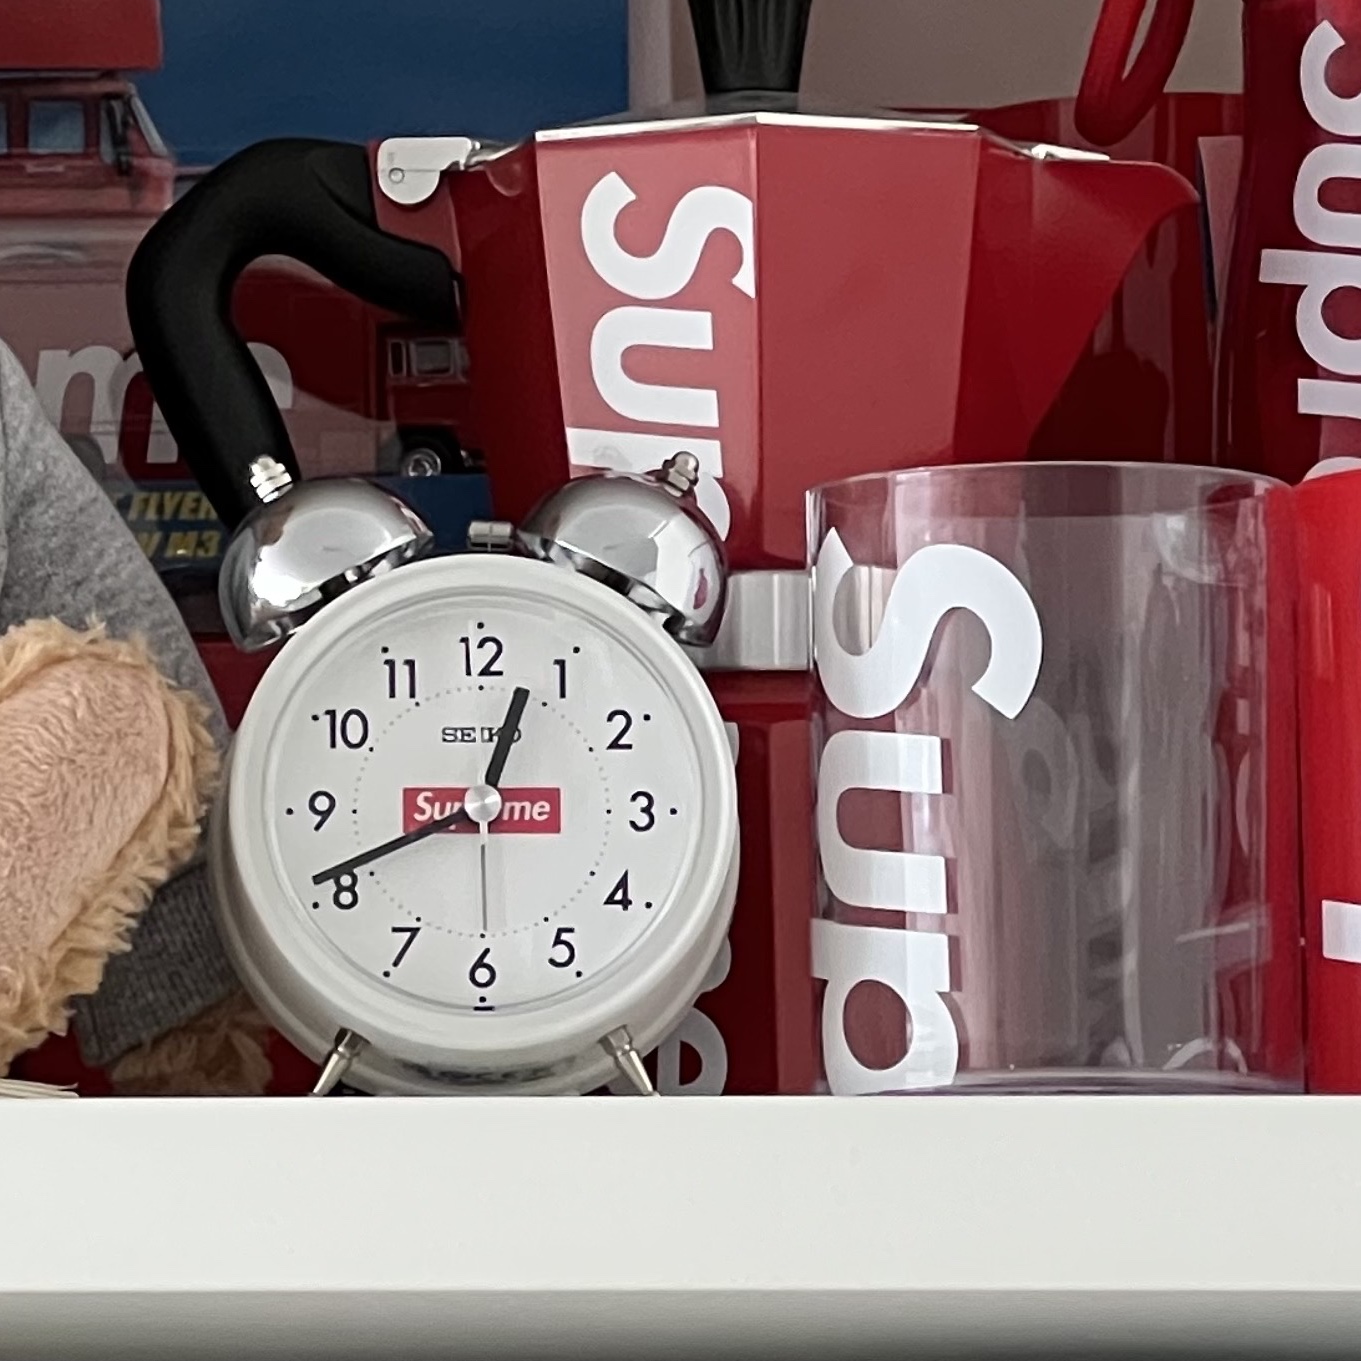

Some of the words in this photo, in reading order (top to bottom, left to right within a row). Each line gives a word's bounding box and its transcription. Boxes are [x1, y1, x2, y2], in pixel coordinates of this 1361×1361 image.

[459, 636, 504, 677] 12
[383, 658, 417, 699] 11
[553, 658, 567, 699] 1
[323, 708, 370, 749] 10
[606, 709, 633, 750] 2
[307, 790, 336, 832] 9
[628, 790, 656, 833] 3
[811, 526, 1044, 1096] Sup
[332, 869, 359, 911] 8
[603, 869, 633, 911] 4
[391, 926, 421, 968] 7
[468, 947, 497, 989] 6
[547, 927, 576, 968] 5
